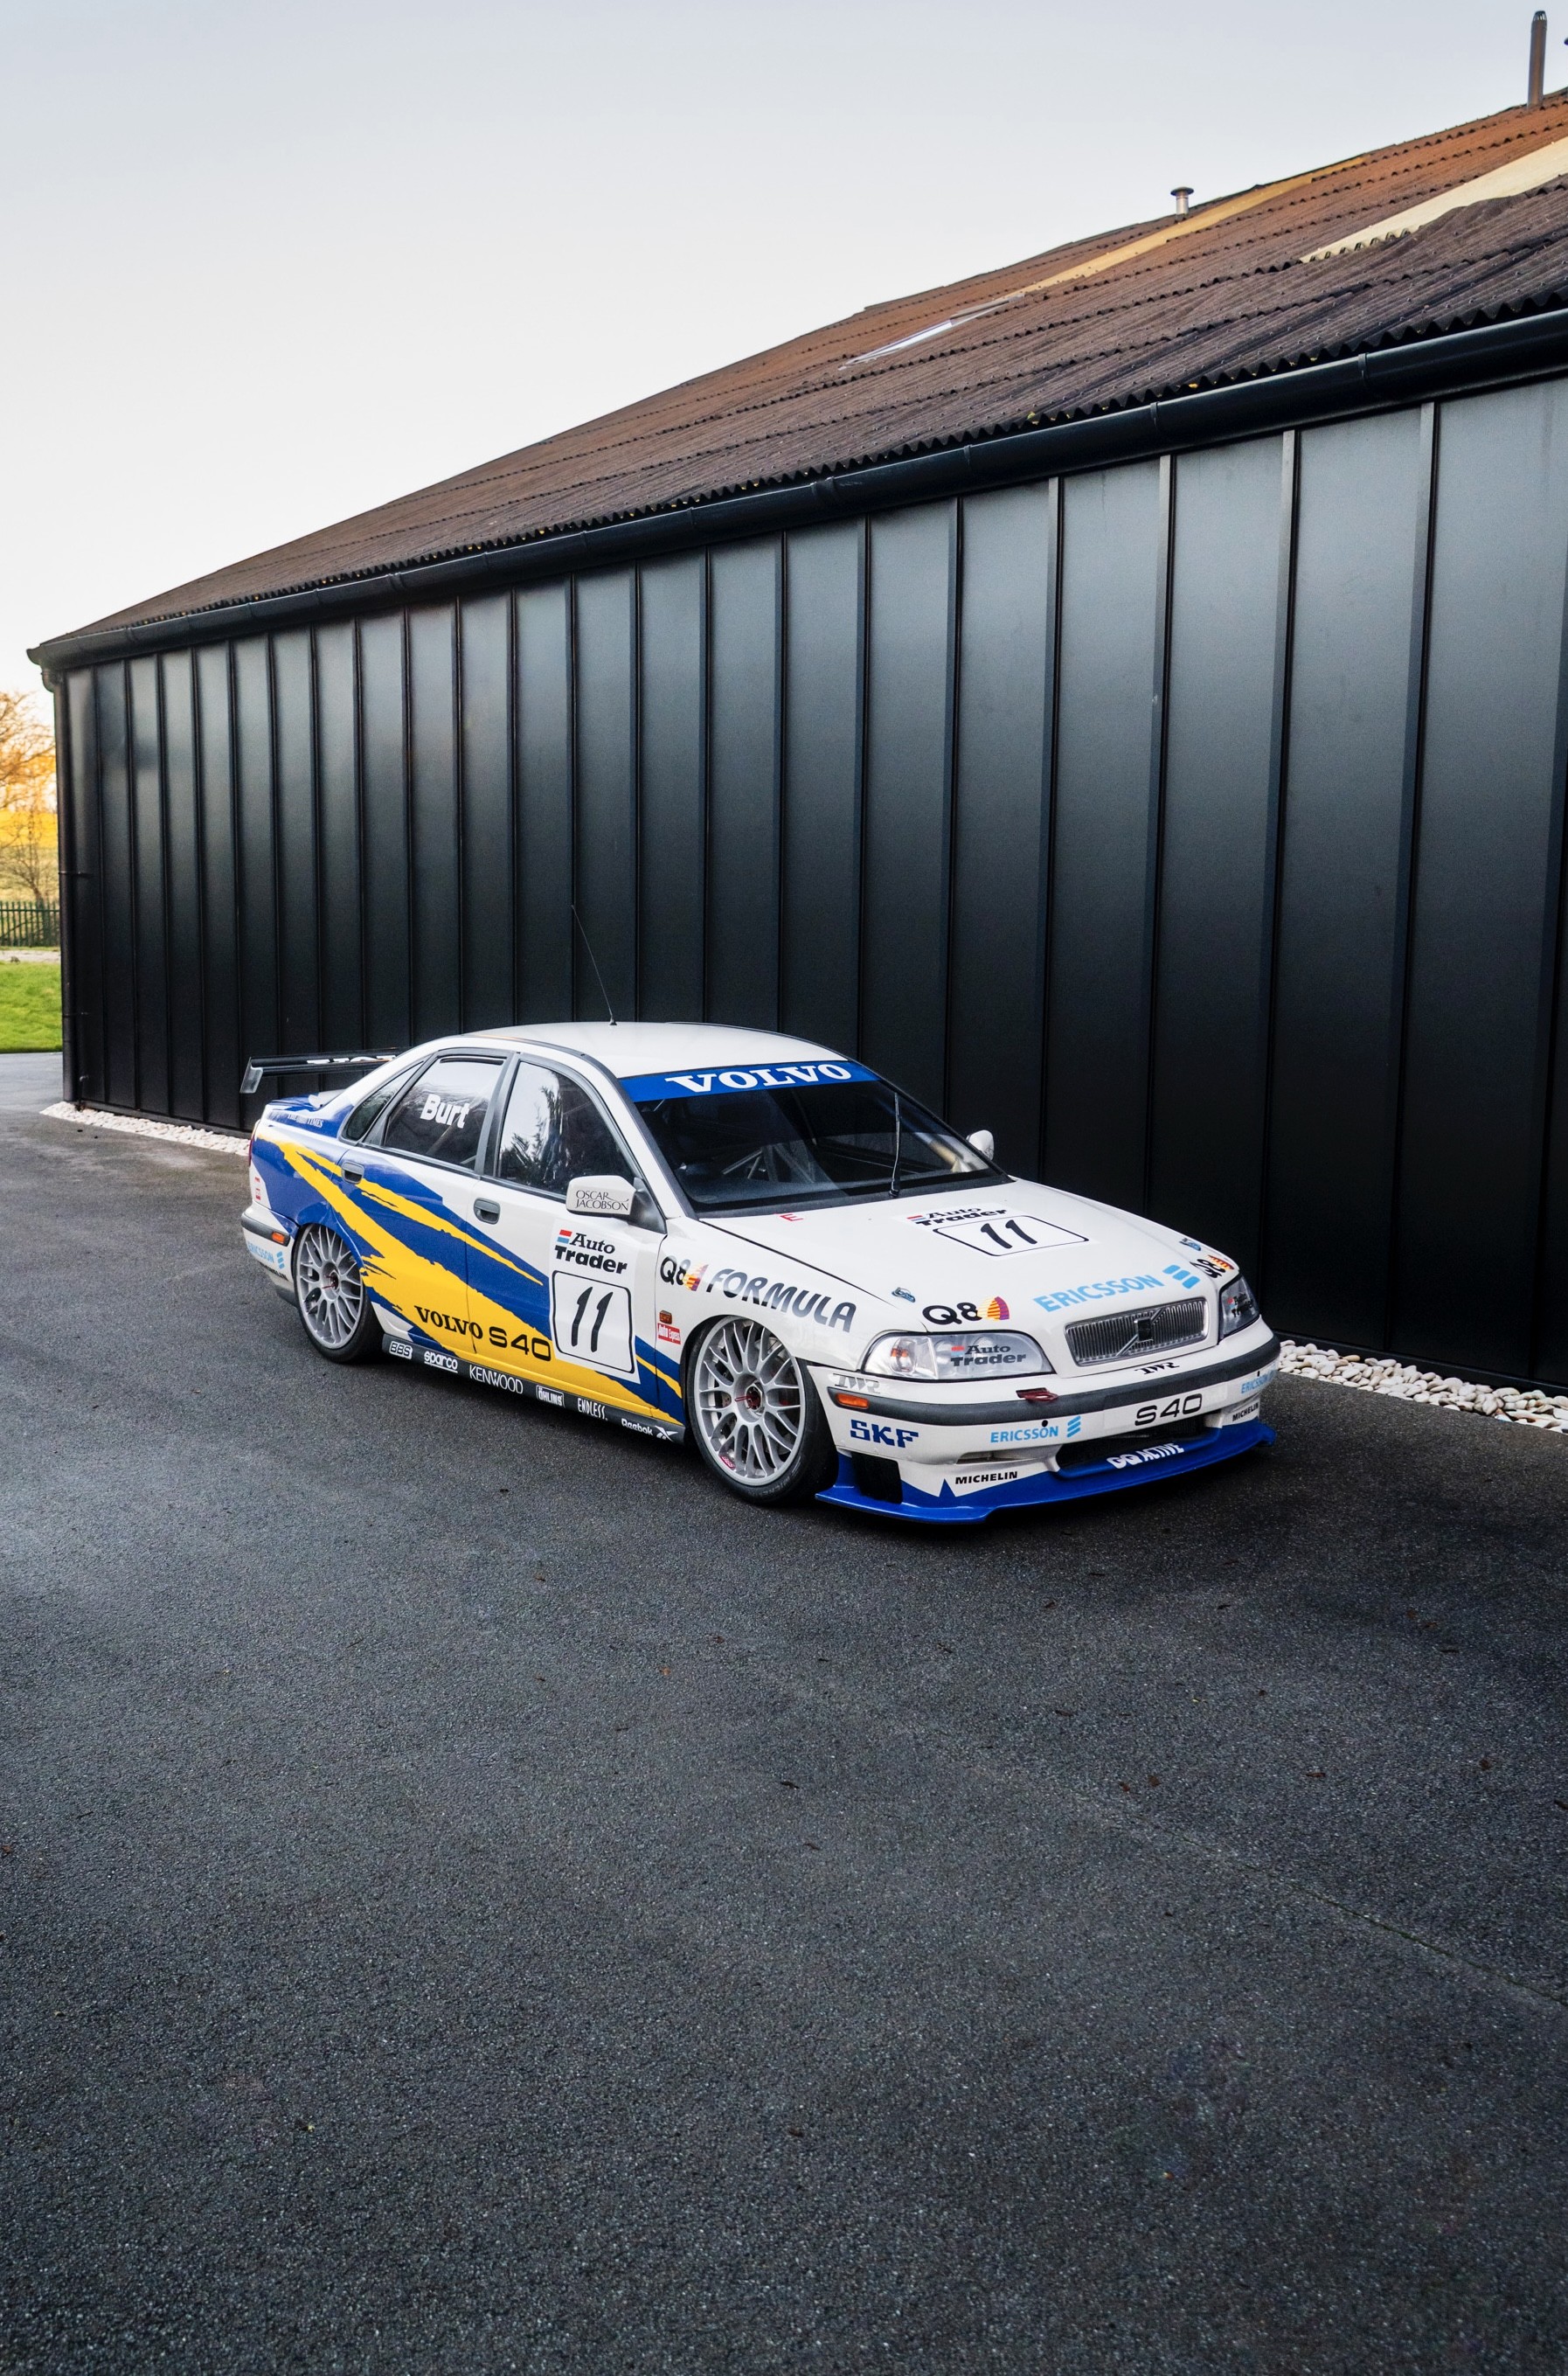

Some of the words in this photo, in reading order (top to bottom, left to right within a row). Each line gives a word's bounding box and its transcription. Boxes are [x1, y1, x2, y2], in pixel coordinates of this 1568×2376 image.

[664, 1064, 851, 1093] VOLVO
[420, 1094, 469, 1129] Burt
[575, 1198, 629, 1212] JACOBSON
[576, 1190, 629, 1203] OSCAR
[915, 1209, 1007, 1226] Trader
[926, 1208, 982, 1219] Auto
[570, 1233, 615, 1254] Auto
[981, 1219, 1037, 1249] 11
[554, 1245, 628, 1275] Trader
[1189, 1258, 1226, 1279] Q8
[660, 1255, 691, 1286] Q8
[705, 1268, 857, 1333] FORMULA
[1033, 1275, 1165, 1312] ERICSSON
[571, 1286, 614, 1352] 11
[922, 1302, 982, 1325] Q8
[414, 1305, 483, 1339] VOLVO
[489, 1326, 552, 1361] S40
[390, 1341, 412, 1358] BBS
[950, 1351, 1026, 1367] Trader
[966, 1344, 1011, 1356] Auto
[424, 1351, 458, 1371] sparco
[1134, 1362, 1180, 1375] TWR
[469, 1365, 524, 1394] KENWOOD
[1134, 1393, 1203, 1427] S40
[1232, 1402, 1259, 1421] MICHELIN
[621, 1418, 653, 1435] Reebok
[850, 1419, 919, 1449] SKF
[990, 1425, 1058, 1443] ERICSSON
[1136, 1442, 1184, 1462] ACTIVE
[955, 1470, 1017, 1484] MICHELIN
